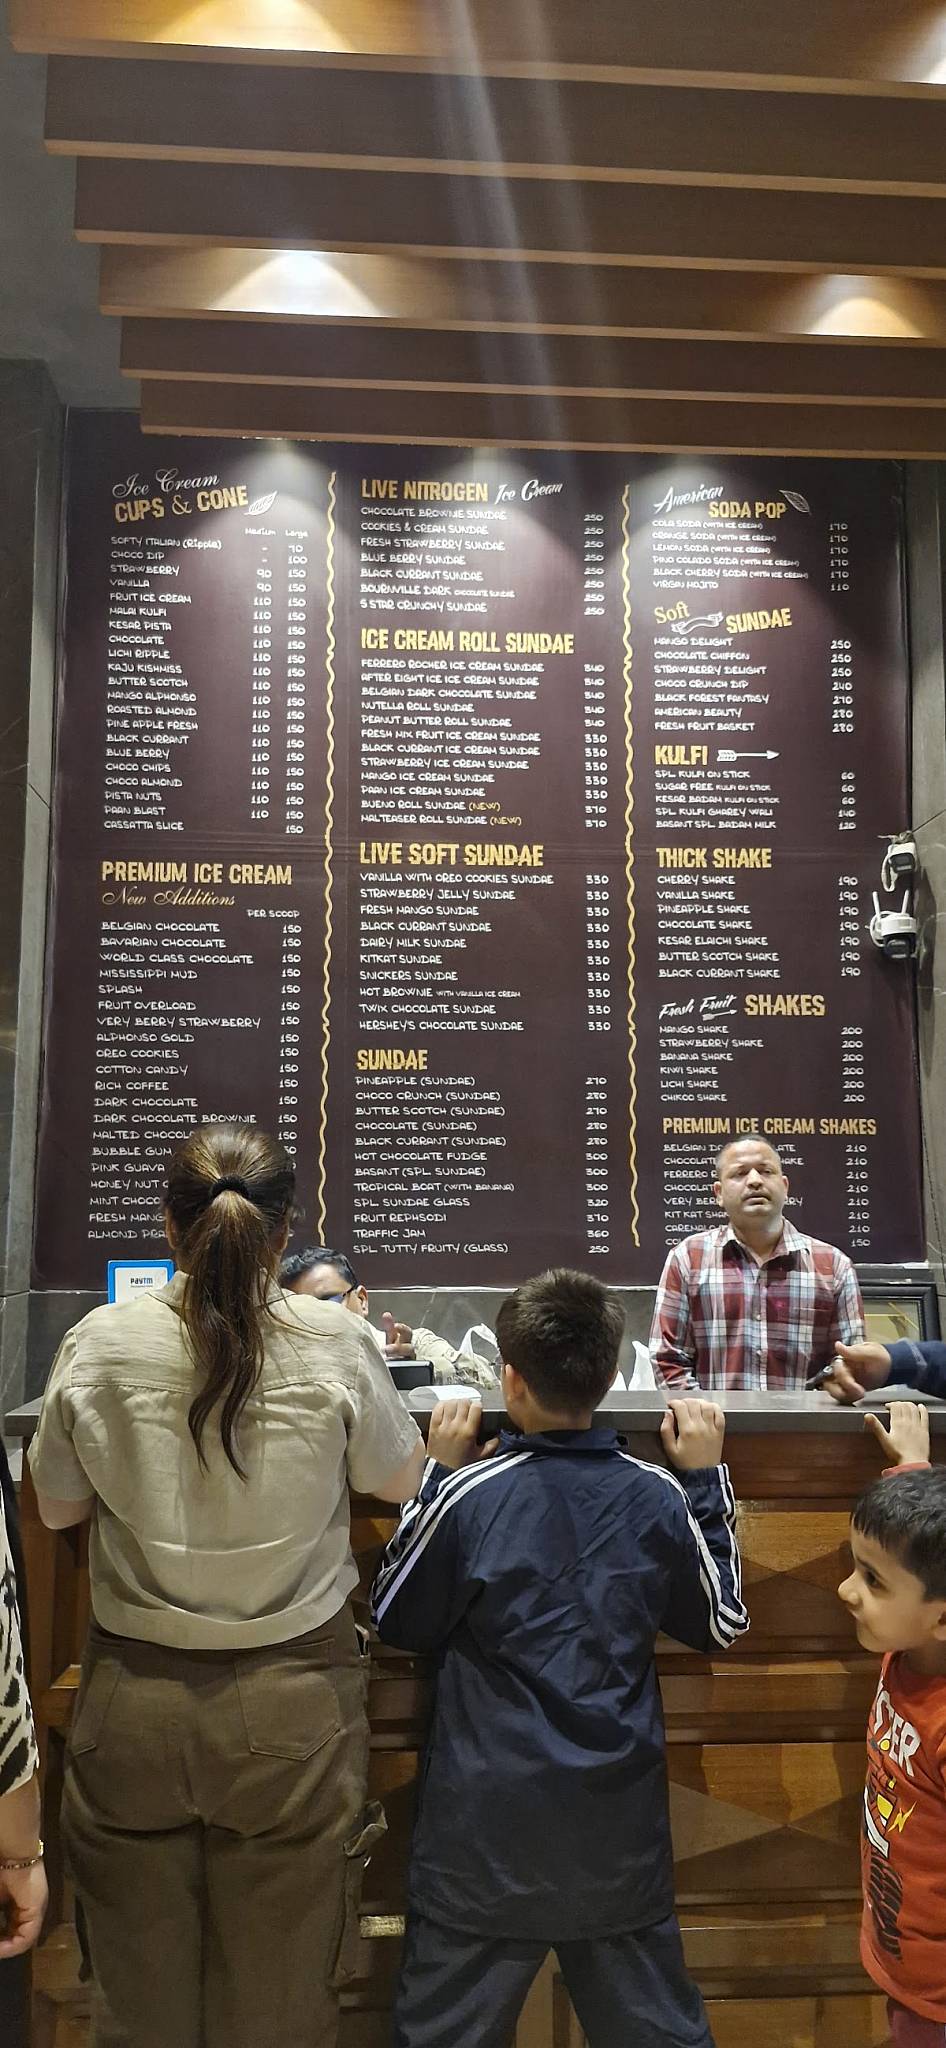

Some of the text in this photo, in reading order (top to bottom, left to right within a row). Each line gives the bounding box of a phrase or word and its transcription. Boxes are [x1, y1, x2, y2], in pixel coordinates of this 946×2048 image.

[112, 468, 220, 498] Ice Cream
[362, 478, 563, 505] LIVE NITROGEN Ice Cream
[653, 484, 724, 514] American
[114, 486, 249, 523] CUPS & CONE
[708, 501, 788, 518] SODA POP
[110, 564, 179, 576] STRAWBERRY
[256, 568, 272, 578] 90
[288, 568, 306, 578] 150
[109, 579, 150, 587] VANILLA
[256, 582, 272, 592] 90
[288, 583, 306, 592] 150
[654, 601, 793, 634] Soft SUNDAE
[109, 620, 171, 630] KESAR PISTA
[253, 624, 271, 634] 110
[287, 626, 306, 635] 150
[108, 635, 164, 644] CHOCOLATE
[253, 638, 271, 648] 110
[287, 640, 306, 649] 150
[361, 627, 574, 654] ICE CREAM ROLL SUNDAE
[361, 658, 544, 672] FERRERO ROCHER ICE CREAM SUNDAE
[654, 664, 767, 675] STRAWBERRY DELIGHT
[831, 667, 852, 677] 250
[107, 676, 188, 687] BUTTER SCOTCH
[252, 681, 271, 690] 110
[287, 682, 305, 692] 150
[654, 707, 742, 718] AMERICAN BEAUTY
[832, 709, 853, 718] 280
[654, 721, 755, 731] FRESH FRUIT BASKET
[832, 723, 854, 732] 280
[655, 745, 708, 765] KULFI
[360, 756, 529, 769] STRAWBERRY ICE CREAM SUNDAE
[584, 761, 607, 771] 330
[361, 799, 500, 812] BUENO ROLL SUNDAE (NEW)
[104, 820, 184, 830] CASSATTA SLICE
[285, 824, 303, 833] 150
[360, 842, 544, 866] LIVE SOFT SUNDAE
[656, 847, 772, 868] THICK SHAKE
[102, 861, 292, 885] PREMIUM ICE CREAM
[360, 872, 554, 884] VANILLA WITH OREO COOKIES SUNDAE
[586, 874, 609, 884] 330
[657, 874, 736, 886] CHERRY SHAKE
[838, 876, 858, 885] 190
[102, 885, 235, 906] New Additions
[247, 909, 300, 918] PER SCOOP
[101, 921, 220, 932] BELGIAN CHOCOLATE
[282, 924, 302, 933] 150
[99, 952, 254, 964] WORLD CLASS CHOCOLATE
[282, 953, 301, 963] 150
[360, 954, 442, 964] KITKAT SUNDAE
[587, 955, 610, 965] 330
[658, 951, 779, 961] BUTTER SCOTCH SHAKE
[840, 951, 860, 961] 190
[658, 968, 780, 978] BLACK CURRANT SHAKE
[841, 967, 861, 976] 190
[98, 984, 142, 994] SPLASH
[281, 984, 300, 993] 150
[98, 1000, 196, 1010] FRUIT OVERLOAD
[281, 1001, 300, 1011] 150
[659, 994, 825, 1020] Fresh Fruit SHAKES
[96, 1016, 261, 1028] VERY BERRY STRAWBERRY
[280, 1016, 300, 1025] 150
[359, 1019, 524, 1032] HERSHEY'S CHOCOLATE SUNDAE
[588, 1021, 611, 1031] 330
[659, 1038, 764, 1048] STRAWBERRY SHAKE
[841, 1040, 863, 1048] 200
[96, 1048, 179, 1058] OREO COOKIES
[280, 1047, 299, 1056] 150
[356, 1049, 428, 1070] SUNDAE
[95, 1065, 188, 1076] COTTON CANDY
[279, 1063, 299, 1073] 150
[660, 1066, 718, 1074] KIWI SHAKE
[842, 1067, 864, 1075] 200
[93, 1113, 257, 1123] DARK CHOCOLATE BROWNIE
[278, 1114, 297, 1123] 150
[663, 1117, 876, 1135] PREMIUM ICE CREAM SHAKES
[92, 1146, 172, 1156] BUBBLE GUM
[354, 1152, 487, 1160] HOT CHOCOLATE FUDGE
[585, 1152, 608, 1160] 300
[352, 1228, 426, 1238] TRAFFIC JAM
[587, 1230, 609, 1238] 360
